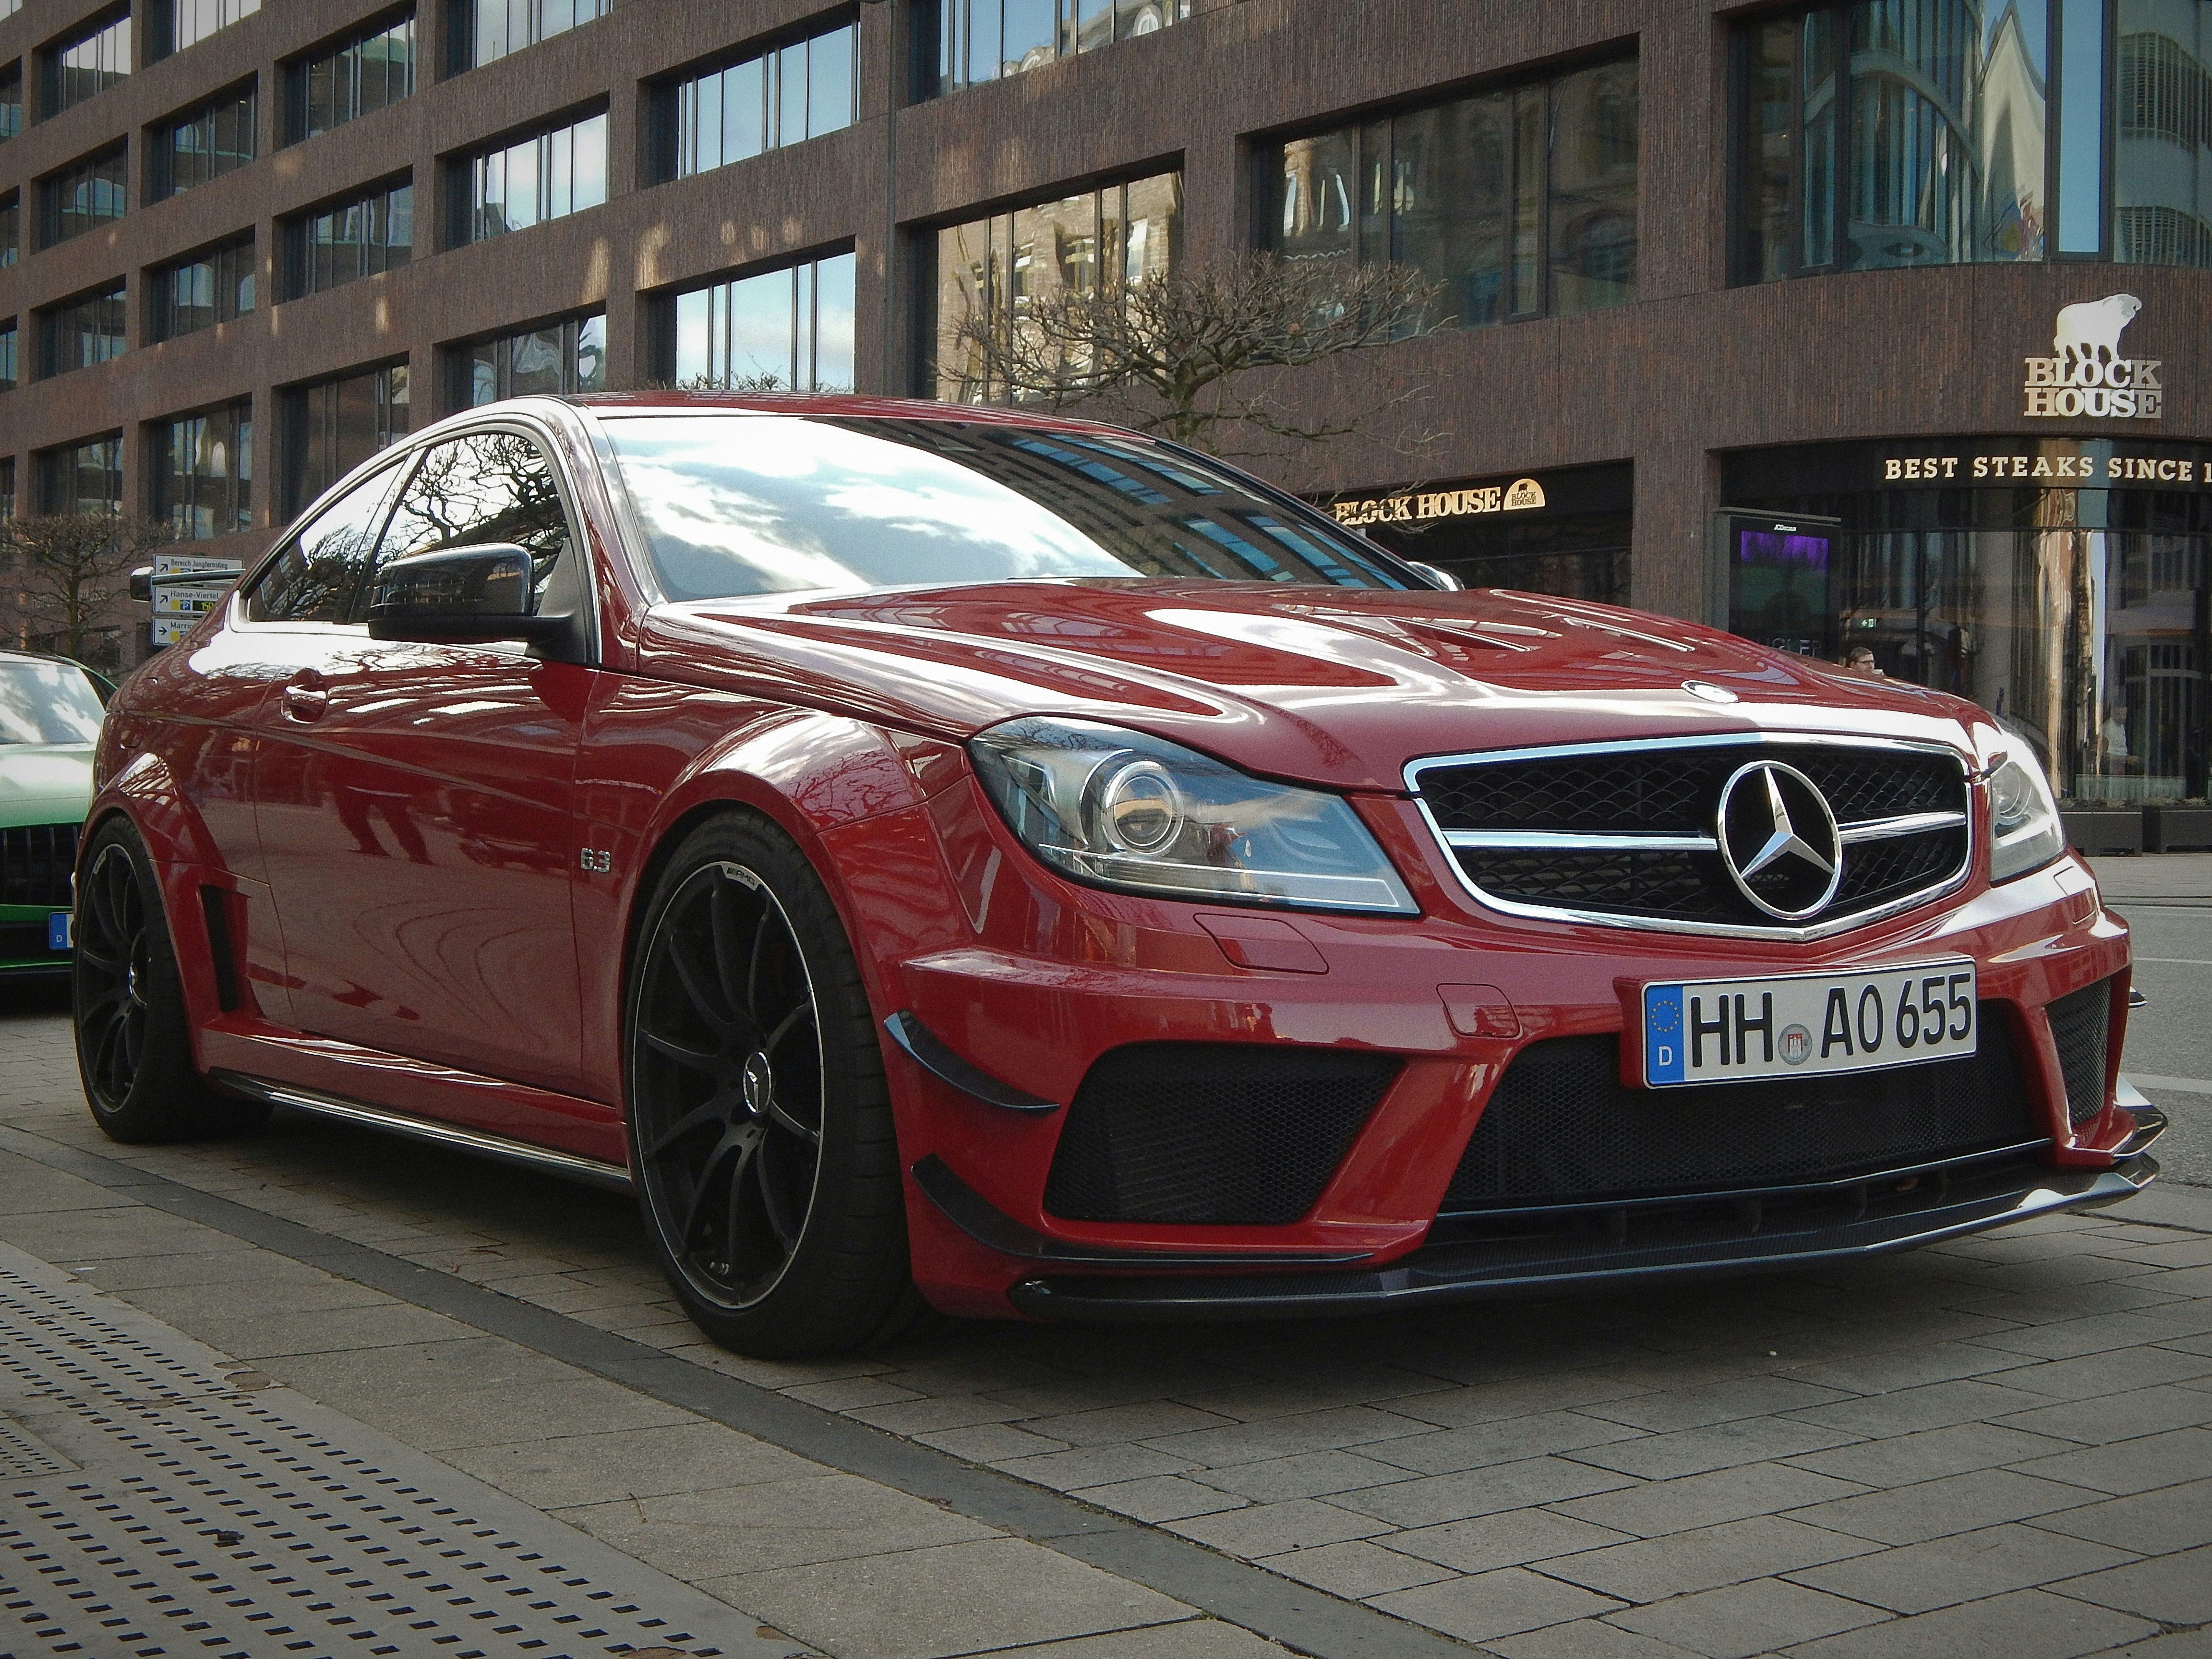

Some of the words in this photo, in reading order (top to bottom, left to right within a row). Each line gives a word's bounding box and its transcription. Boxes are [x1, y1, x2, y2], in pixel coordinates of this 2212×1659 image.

[2024, 358, 2162, 388] BLOCK
[2024, 388, 2162, 419] HOUSE
[1885, 457, 1958, 479] BEST
[1973, 457, 2094, 477] STEAKS
[2108, 457, 2192, 481] SINCE
[1417, 487, 1501, 519] HOUSE
[1512, 492, 1536, 500] BLOCK
[192, 561, 228, 570] Jungfernstieg
[170, 590, 219, 599] Hanse-Viertel
[1691, 992, 1773, 1068] HH
[1821, 984, 1884, 1058] AO
[1896, 972, 1971, 1048] 655
[1659, 1046, 1673, 1066] D
